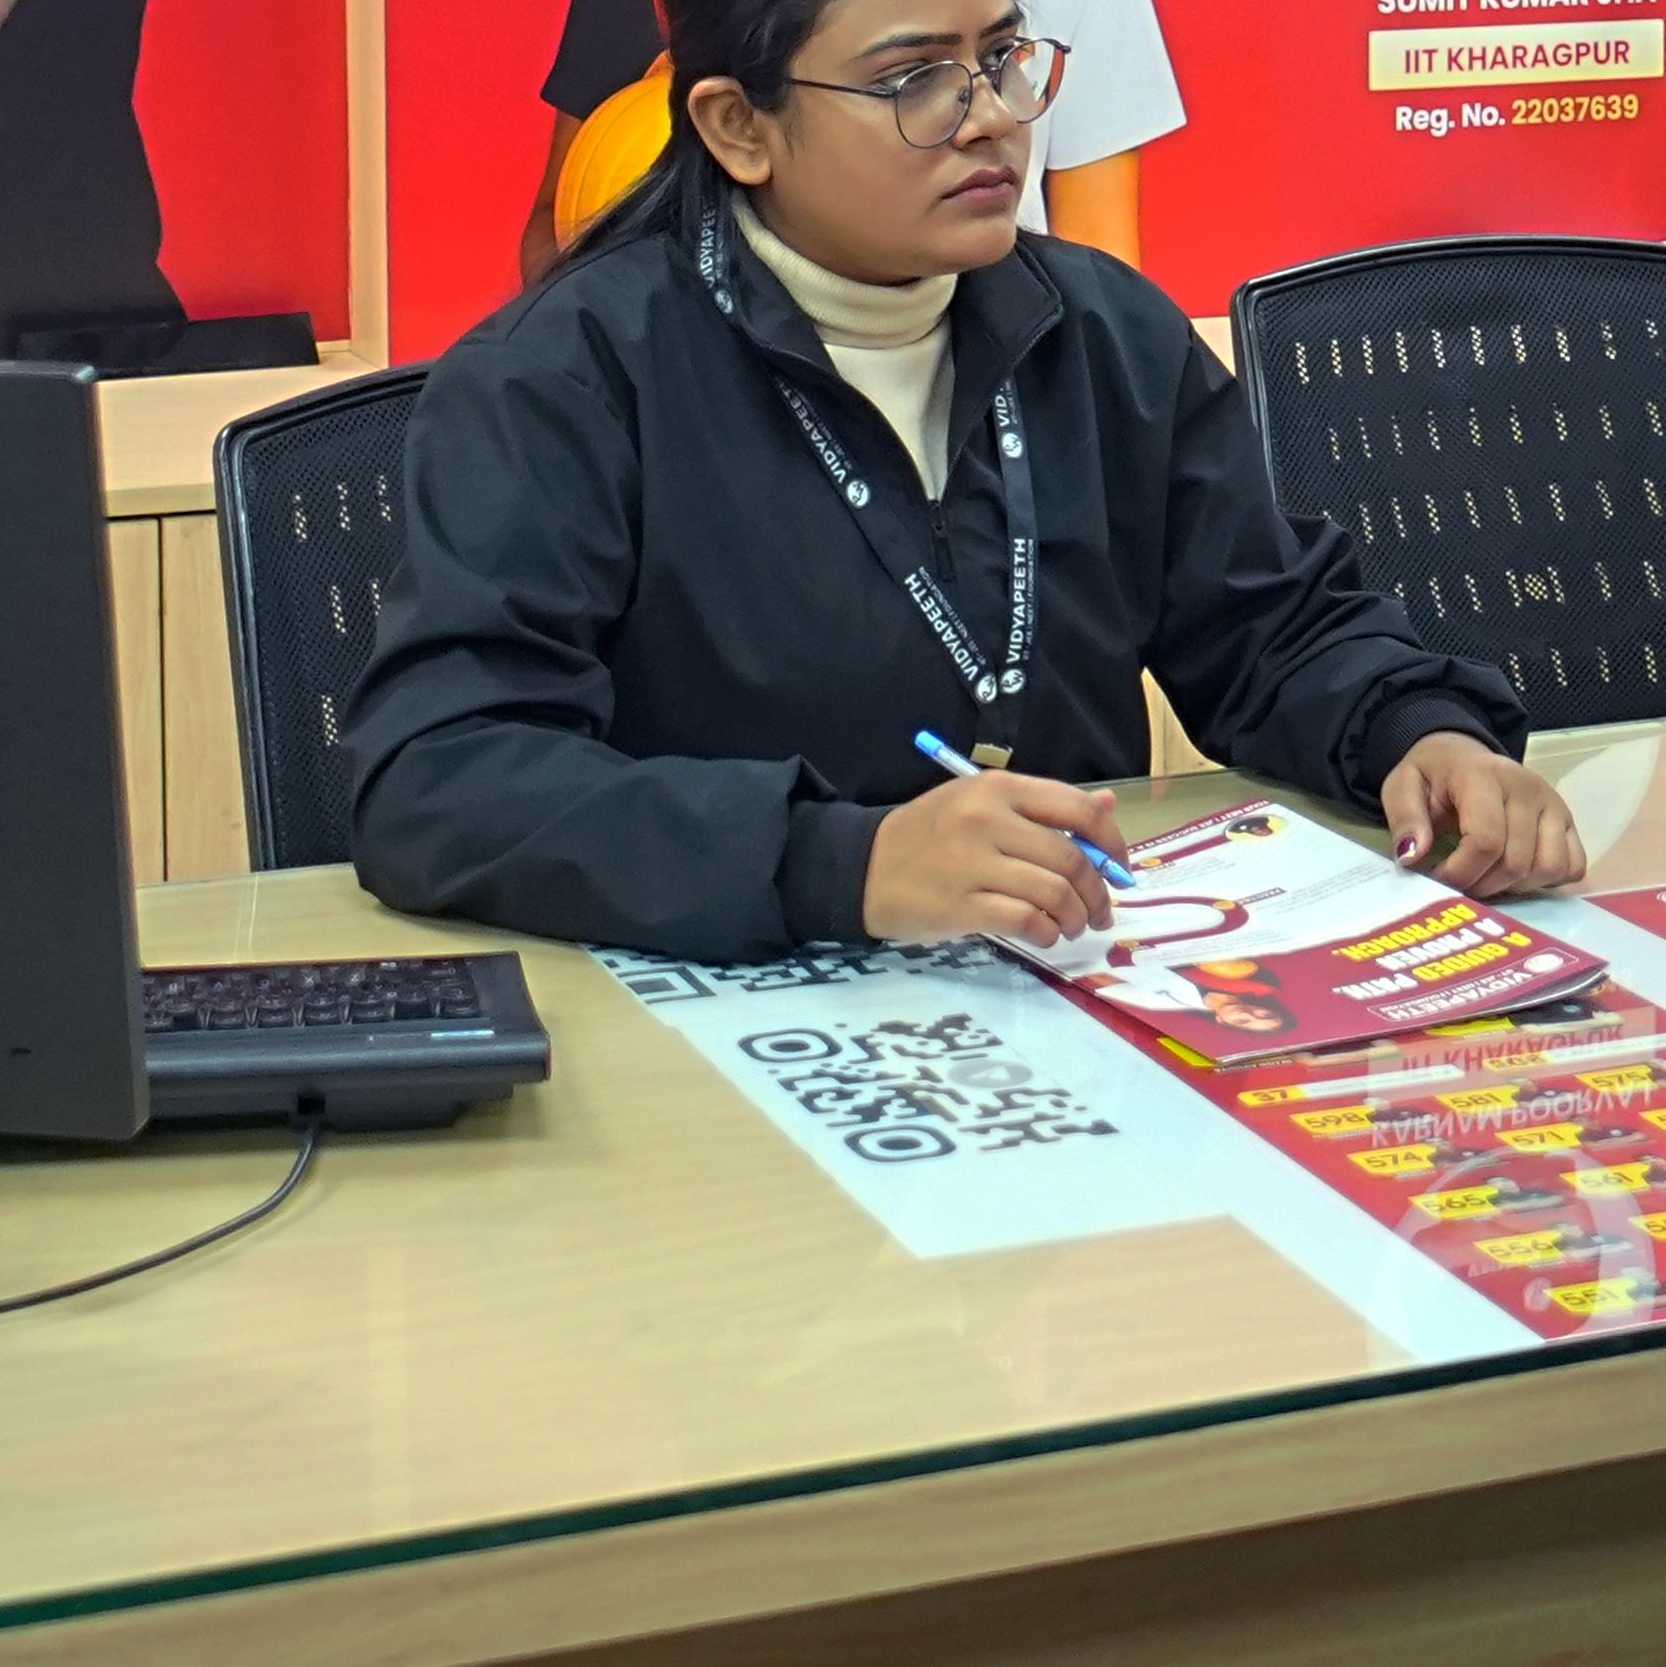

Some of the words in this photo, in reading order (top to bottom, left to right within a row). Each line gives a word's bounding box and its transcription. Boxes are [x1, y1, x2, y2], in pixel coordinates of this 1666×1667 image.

[1404, 49, 1437, 75] IIT
[1448, 41, 1630, 72] KHARAGPUR
[1396, 103, 1455, 137] Reg.
[1461, 100, 1505, 129] No.
[1511, 95, 1639, 126] 22037639
[904, 573, 979, 681] VIDYAPEETH
[1006, 538, 1026, 664] VIDYAPEETH
